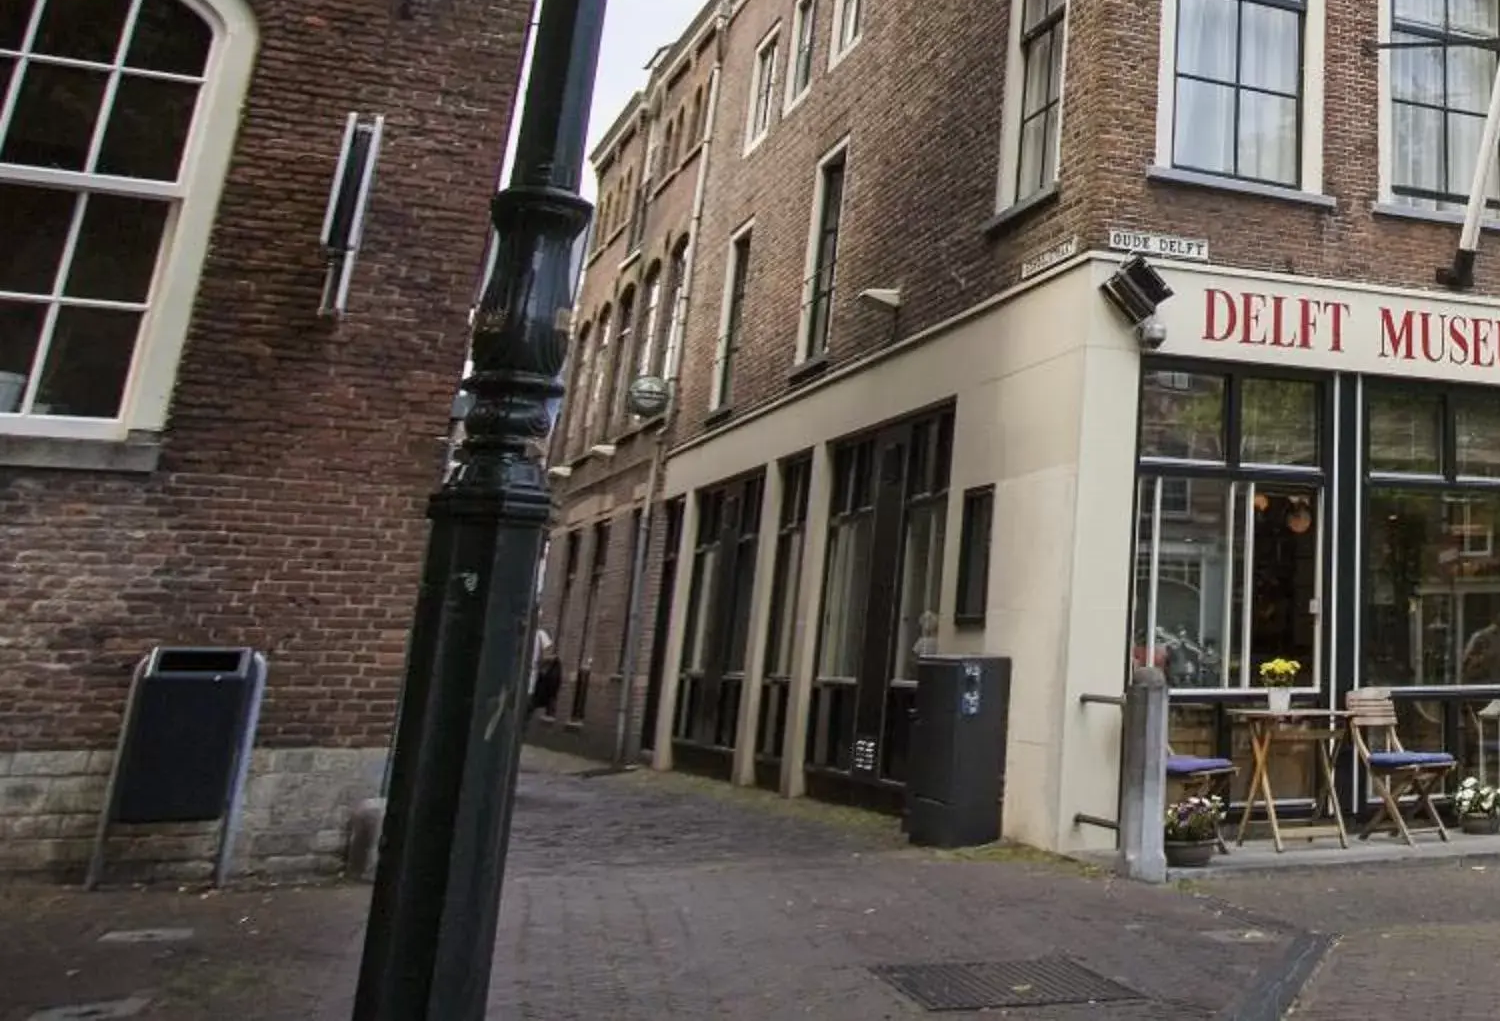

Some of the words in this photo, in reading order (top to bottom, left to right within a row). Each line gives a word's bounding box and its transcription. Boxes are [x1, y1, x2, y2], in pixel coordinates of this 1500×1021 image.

[1112, 231, 1150, 250] OUDE
[1158, 238, 1206, 257] DELFT
[1201, 288, 1351, 353] DELFT
